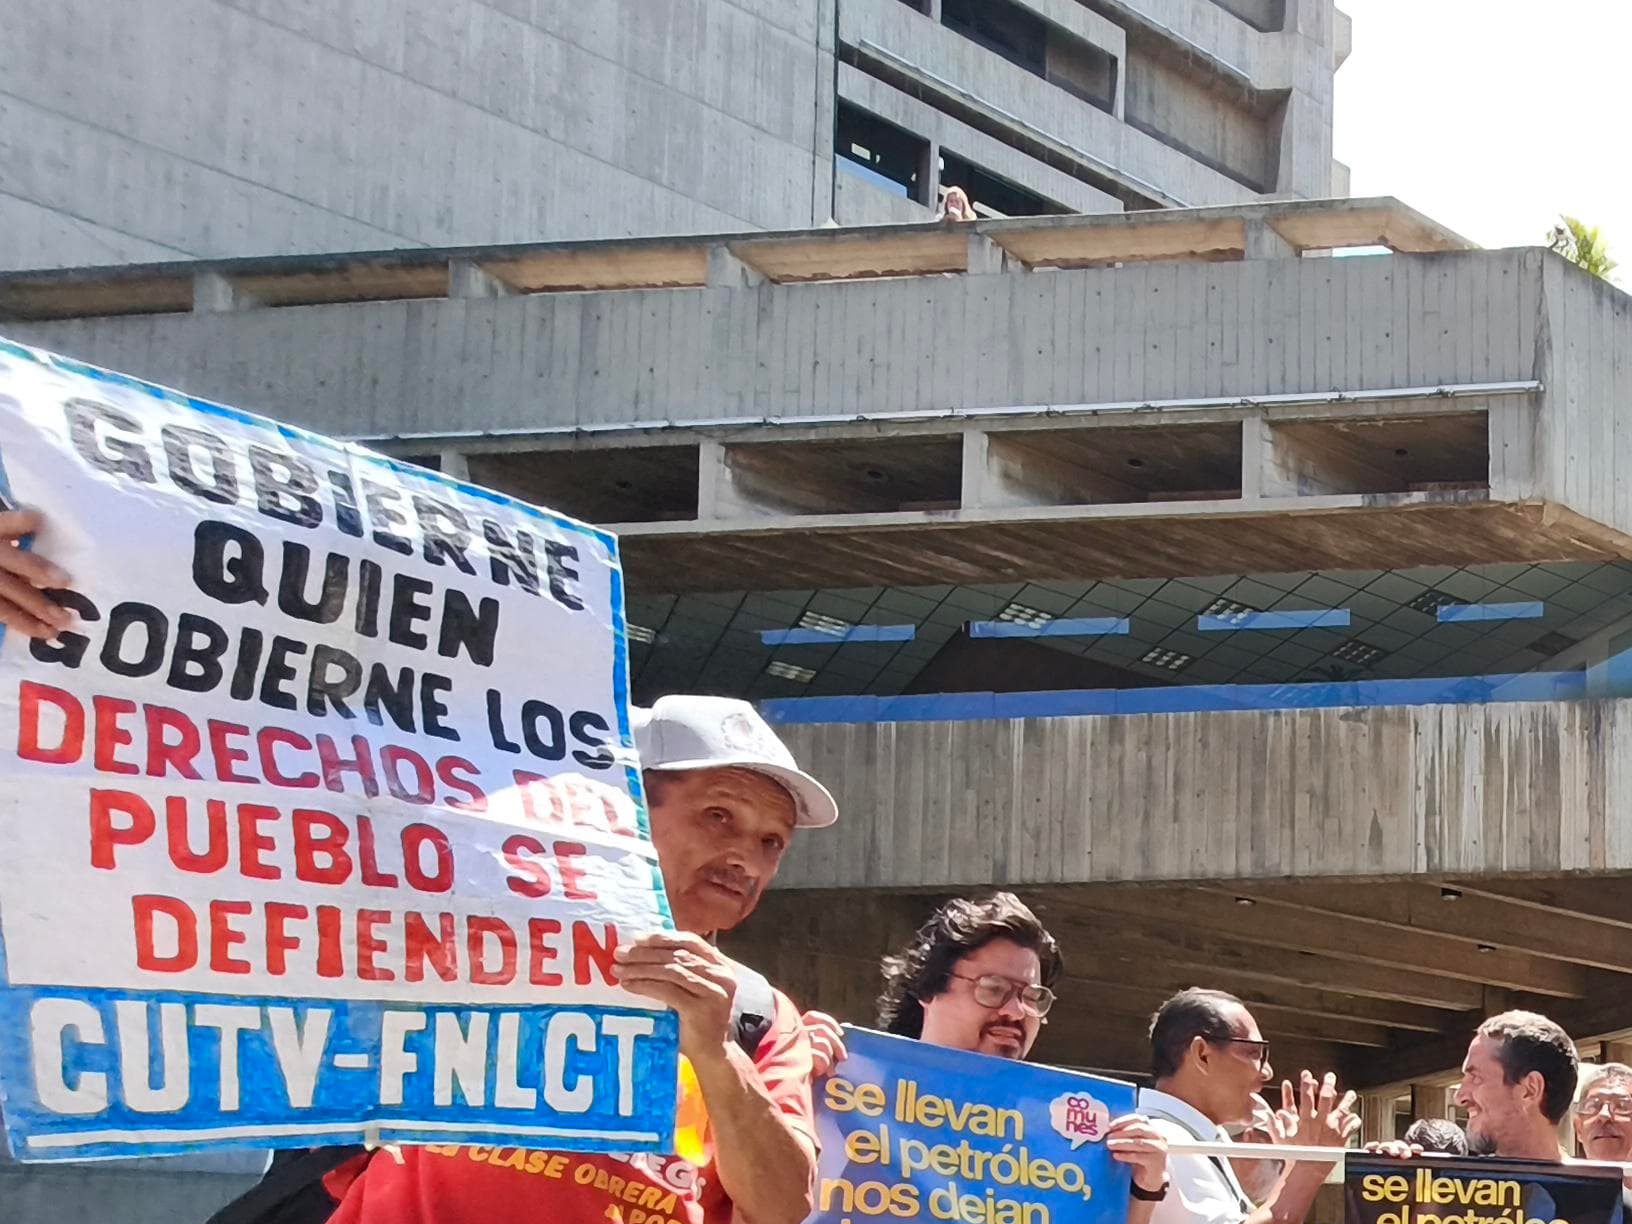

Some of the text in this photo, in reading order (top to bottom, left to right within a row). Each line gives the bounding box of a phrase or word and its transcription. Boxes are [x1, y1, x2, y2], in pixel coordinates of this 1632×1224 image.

[65, 398, 585, 612] GOBIERNE
[192, 520, 498, 667] QUIEN
[28, 589, 616, 770] GOBIERNE LOS
[17, 680, 636, 838] DERECHOS DEL
[90, 789, 598, 900] PUEBLO SE
[131, 895, 623, 988] DEFIENDEN
[30, 997, 654, 1117] CUTV-FNLCT
[825, 1076, 1023, 1140] se llevan
[468, 1146, 569, 1179] CLASE
[574, 1163, 676, 1215] OBRERA
[819, 1177, 920, 1217] nos
[845, 1124, 1091, 1201] el petróleo,
[1362, 1169, 1520, 1206] se llevan
